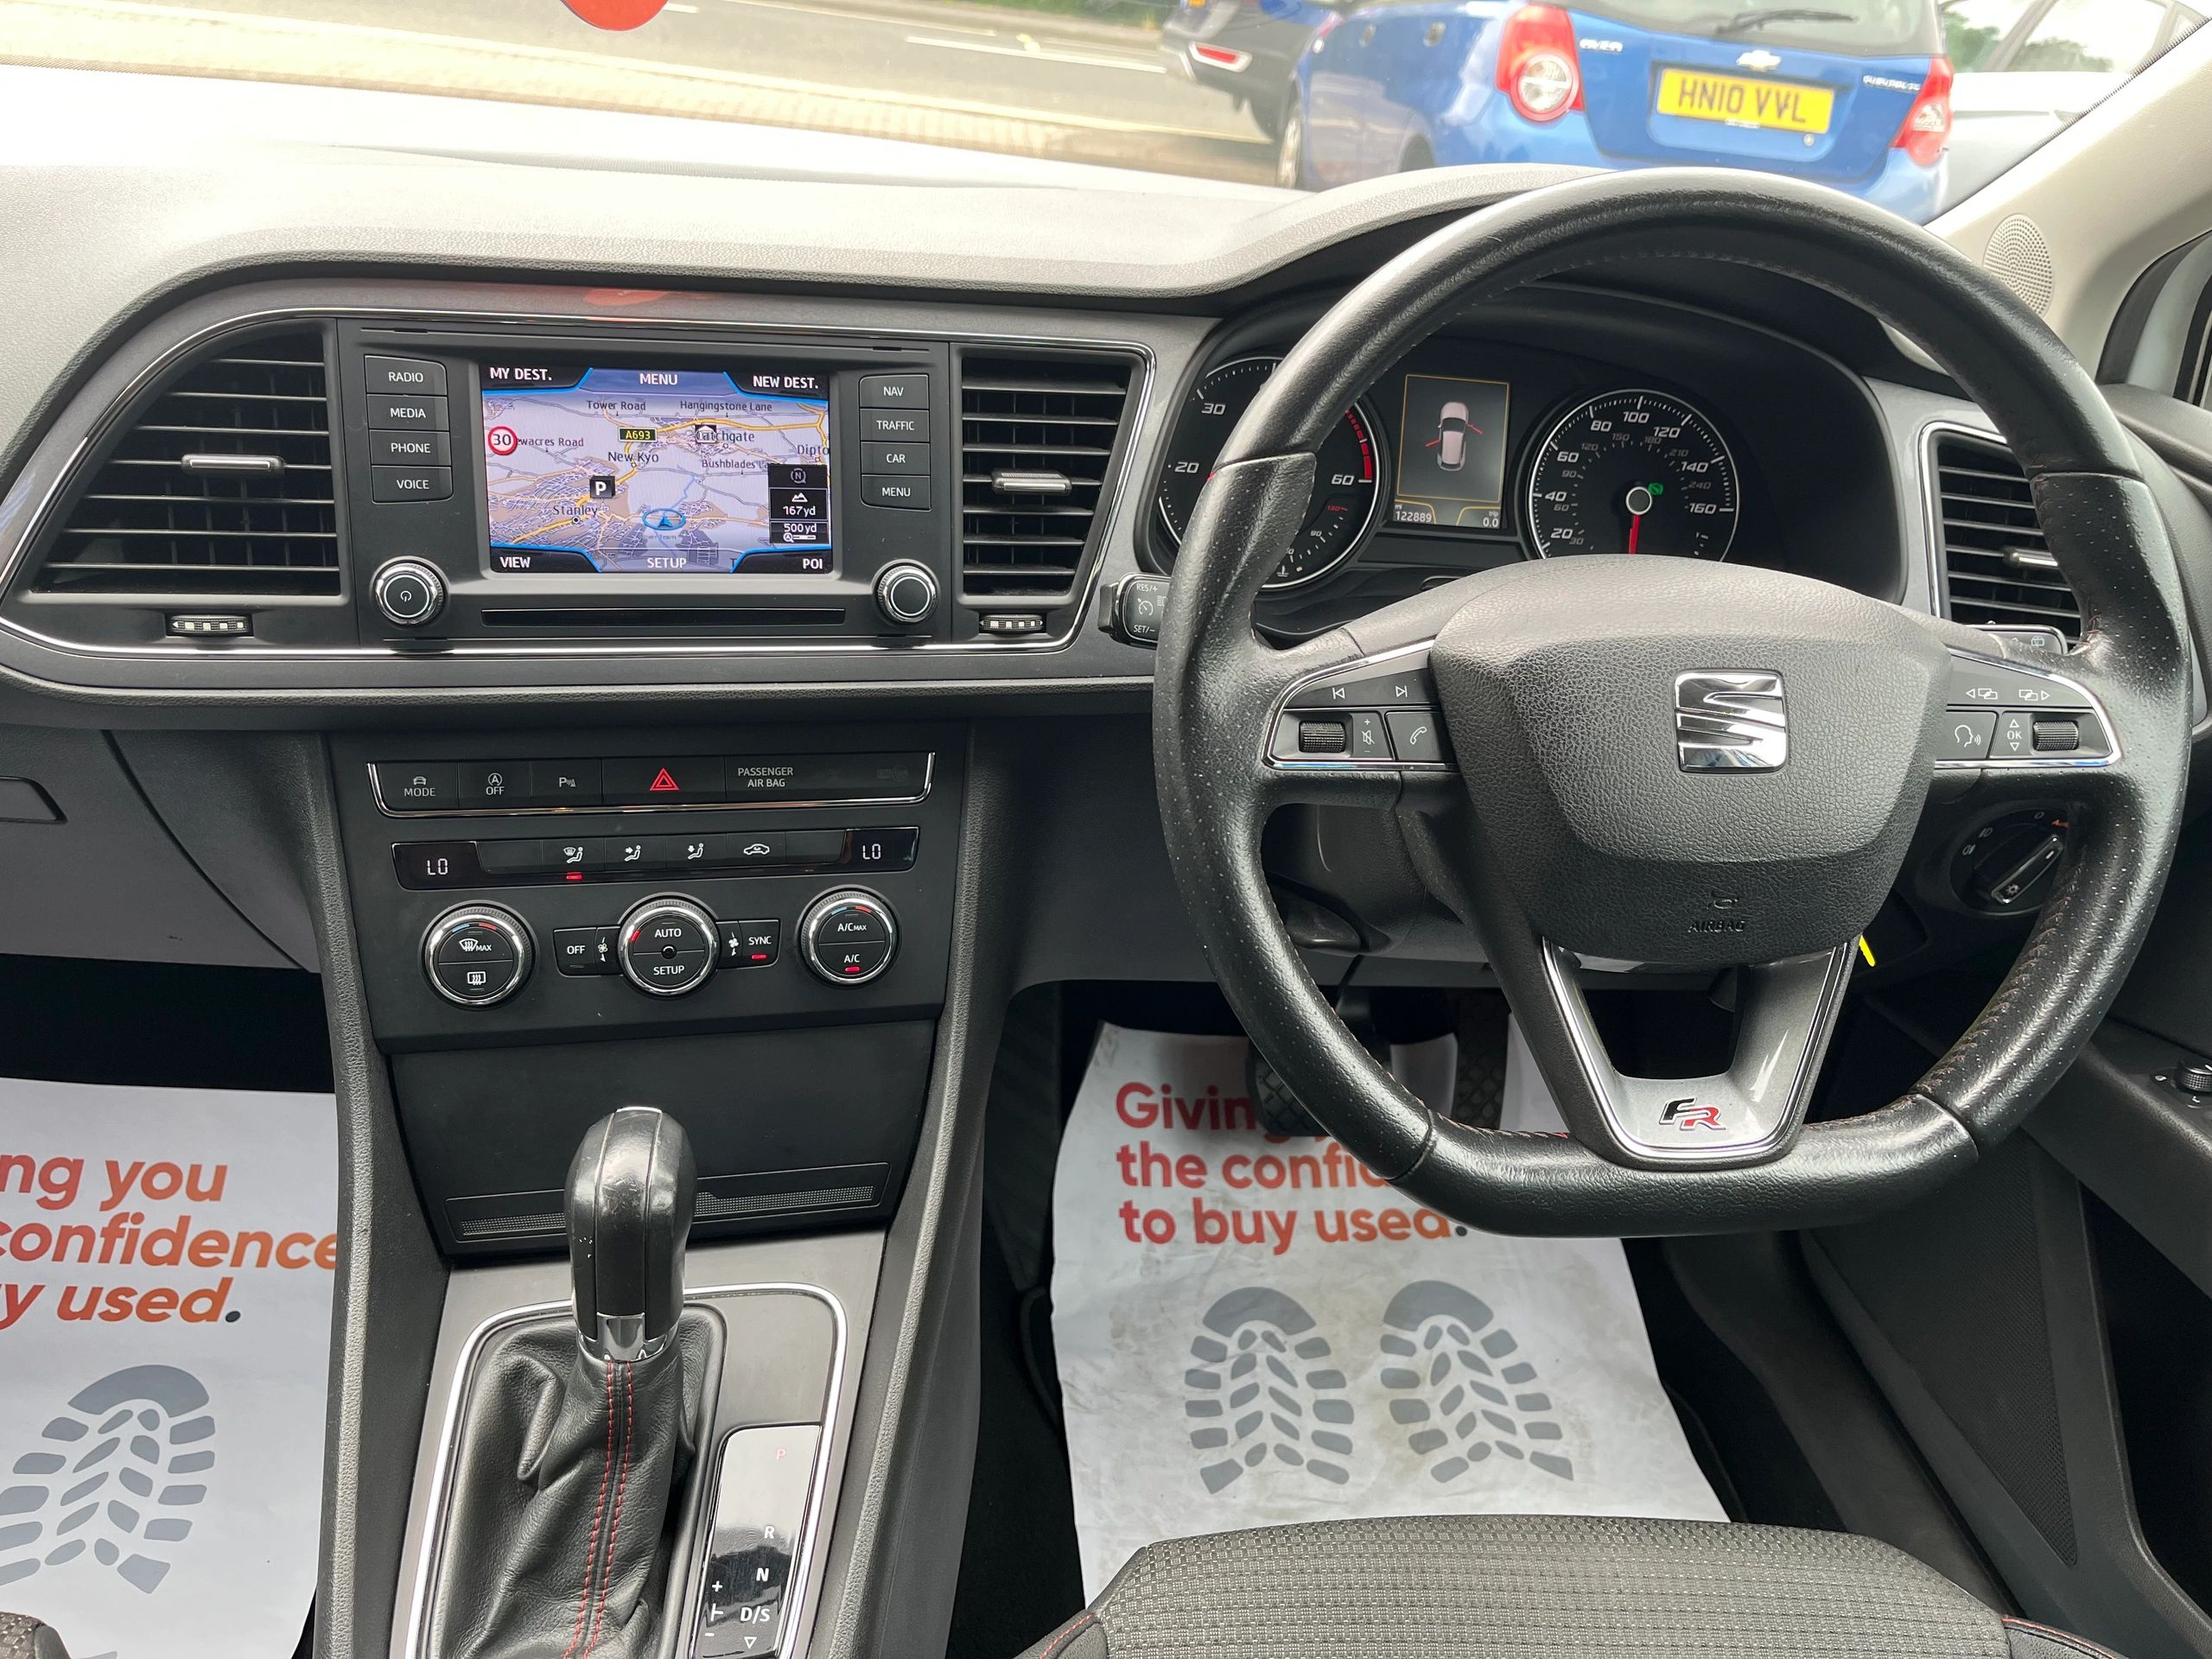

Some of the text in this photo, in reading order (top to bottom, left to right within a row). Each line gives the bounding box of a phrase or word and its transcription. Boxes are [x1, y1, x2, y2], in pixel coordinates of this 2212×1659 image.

[1677, 77, 1806, 124] HN10 VVL
[388, 372, 423, 383] RADIO
[489, 367, 553, 381] MY DEST.
[639, 372, 678, 385] MENU
[753, 375, 819, 389] NEW DEST.
[883, 386, 905, 397] NAV
[587, 400, 646, 411] Tower Road
[680, 400, 772, 412] Hangingstone Lane
[1201, 402, 1226, 416] 30
[390, 408, 427, 419] MEDIA
[1622, 411, 1650, 424] 100
[876, 420, 915, 431] TRAFFIC
[1590, 420, 1612, 432] 80
[625, 430, 652, 441] A693
[1653, 426, 1681, 438] 120
[492, 434, 512, 446] 30
[558, 437, 584, 447] Road
[391, 442, 431, 454] PHONE
[607, 451, 659, 465] New Kyo
[886, 454, 906, 463] CAR
[1557, 452, 1580, 463] 60
[702, 459, 756, 469] Bushblades
[1174, 461, 1199, 474] 20
[1681, 461, 1709, 474] 140
[396, 479, 430, 490] VOICE
[1331, 474, 1355, 486] 60
[594, 481, 607, 496] P
[881, 486, 912, 497] MENU
[1545, 491, 1567, 502] 40
[552, 505, 598, 517] Stanley
[1688, 503, 1717, 515] 160
[1395, 511, 1432, 523] 122889
[1482, 518, 1499, 528] 0.0
[1550, 528, 1573, 540] 20
[499, 556, 531, 569] VIEW
[646, 557, 687, 569] SETUP
[802, 558, 823, 569] POI
[2006, 730, 2023, 741] OK
[737, 766, 794, 777] PASSENGER
[747, 778, 785, 788] AIR BAG
[404, 787, 436, 798] MODE
[485, 786, 505, 796] OFF
[1687, 919, 1749, 933] AIRBAG
[654, 928, 682, 938] AUTO
[748, 936, 772, 946] SYNC
[566, 944, 586, 956] OFF
[843, 953, 861, 963] A/C
[652, 964, 685, 976] SETUP
[1116, 1081, 1272, 1137] Givin
[1658, 1096, 1726, 1131] FR
[1116, 1141, 1208, 1189] the
[99, 1160, 228, 1212] you
[1118, 1199, 1177, 1245] to
[1192, 1197, 1296, 1256] buy
[56, 1276, 242, 1324] used.
[776, 1447, 787, 1460] P
[764, 1525, 775, 1539] R
[756, 1567, 770, 1582] N
[740, 1605, 771, 1624] D/S
